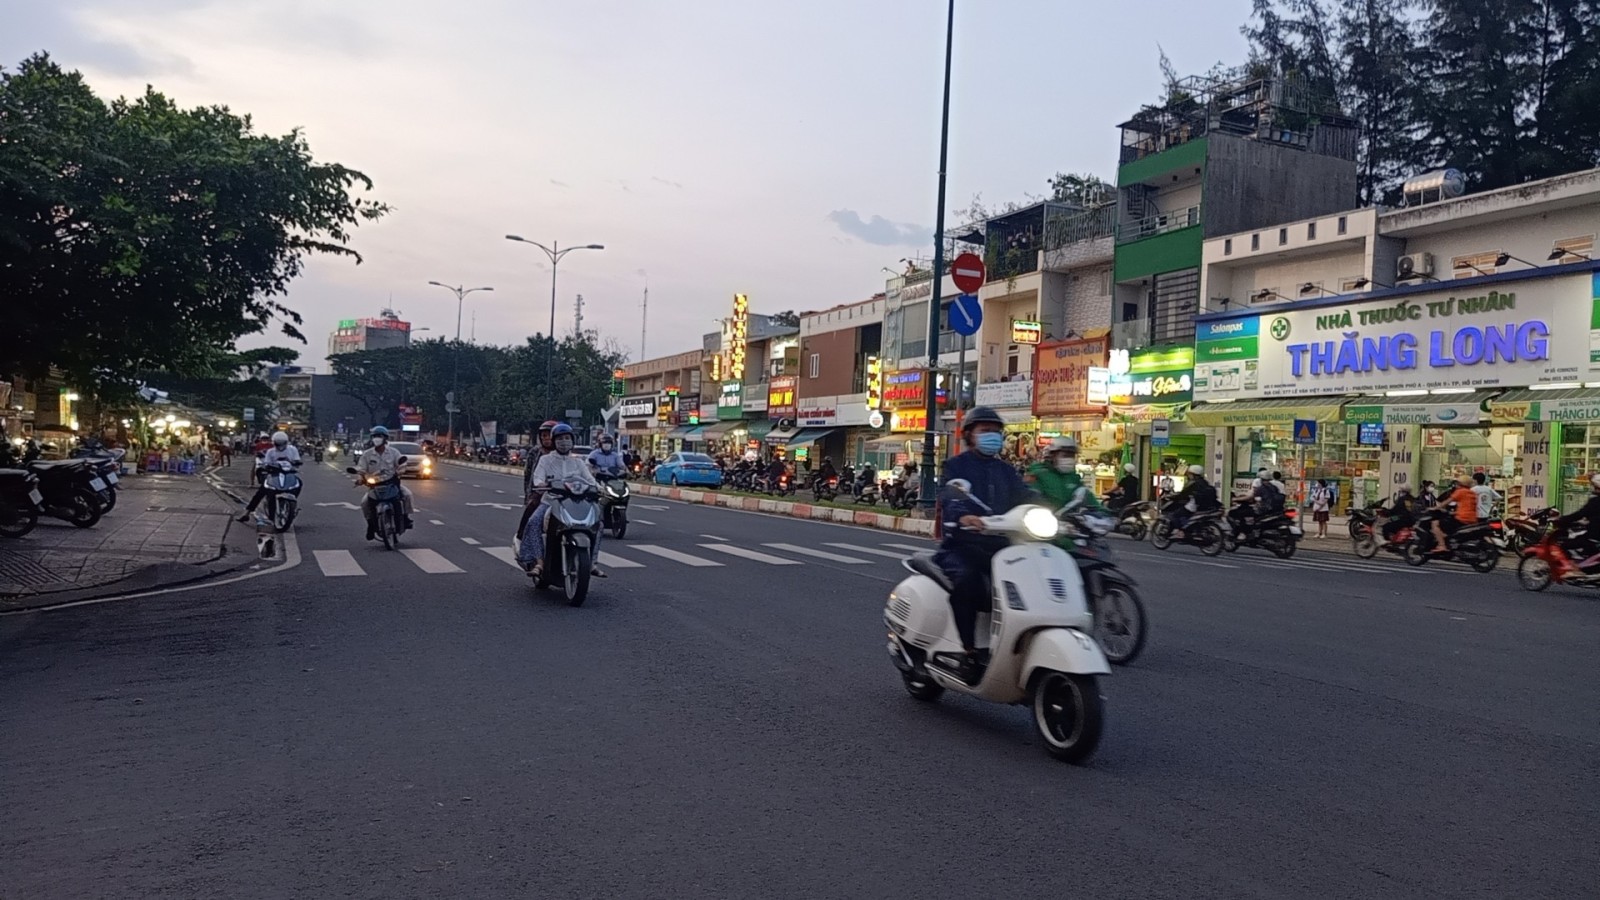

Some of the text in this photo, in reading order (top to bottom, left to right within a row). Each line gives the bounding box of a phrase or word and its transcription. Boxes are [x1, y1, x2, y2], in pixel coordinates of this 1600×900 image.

[1316, 291, 1516, 330] NHÀ THUỐC TƯ NHÂN
[1210, 323, 1244, 334] Salonpas
[1286, 319, 1550, 377] THĂNG LONG
[1346, 410, 1380, 420] Eugica
[1386, 412, 1410, 424] THĂNG
[1410, 413, 1431, 423] LONG
[1492, 406, 1527, 418] ENAT
[1548, 409, 1585, 420] THĂNG
[1396, 429, 1407, 443] MỸ
[1523, 437, 1549, 455] HUYẾT
[1391, 447, 1412, 464] PHẨM
[1531, 460, 1542, 476] ÁP
[1394, 472, 1407, 484] CAO
[1525, 480, 1544, 498] MIỄN
